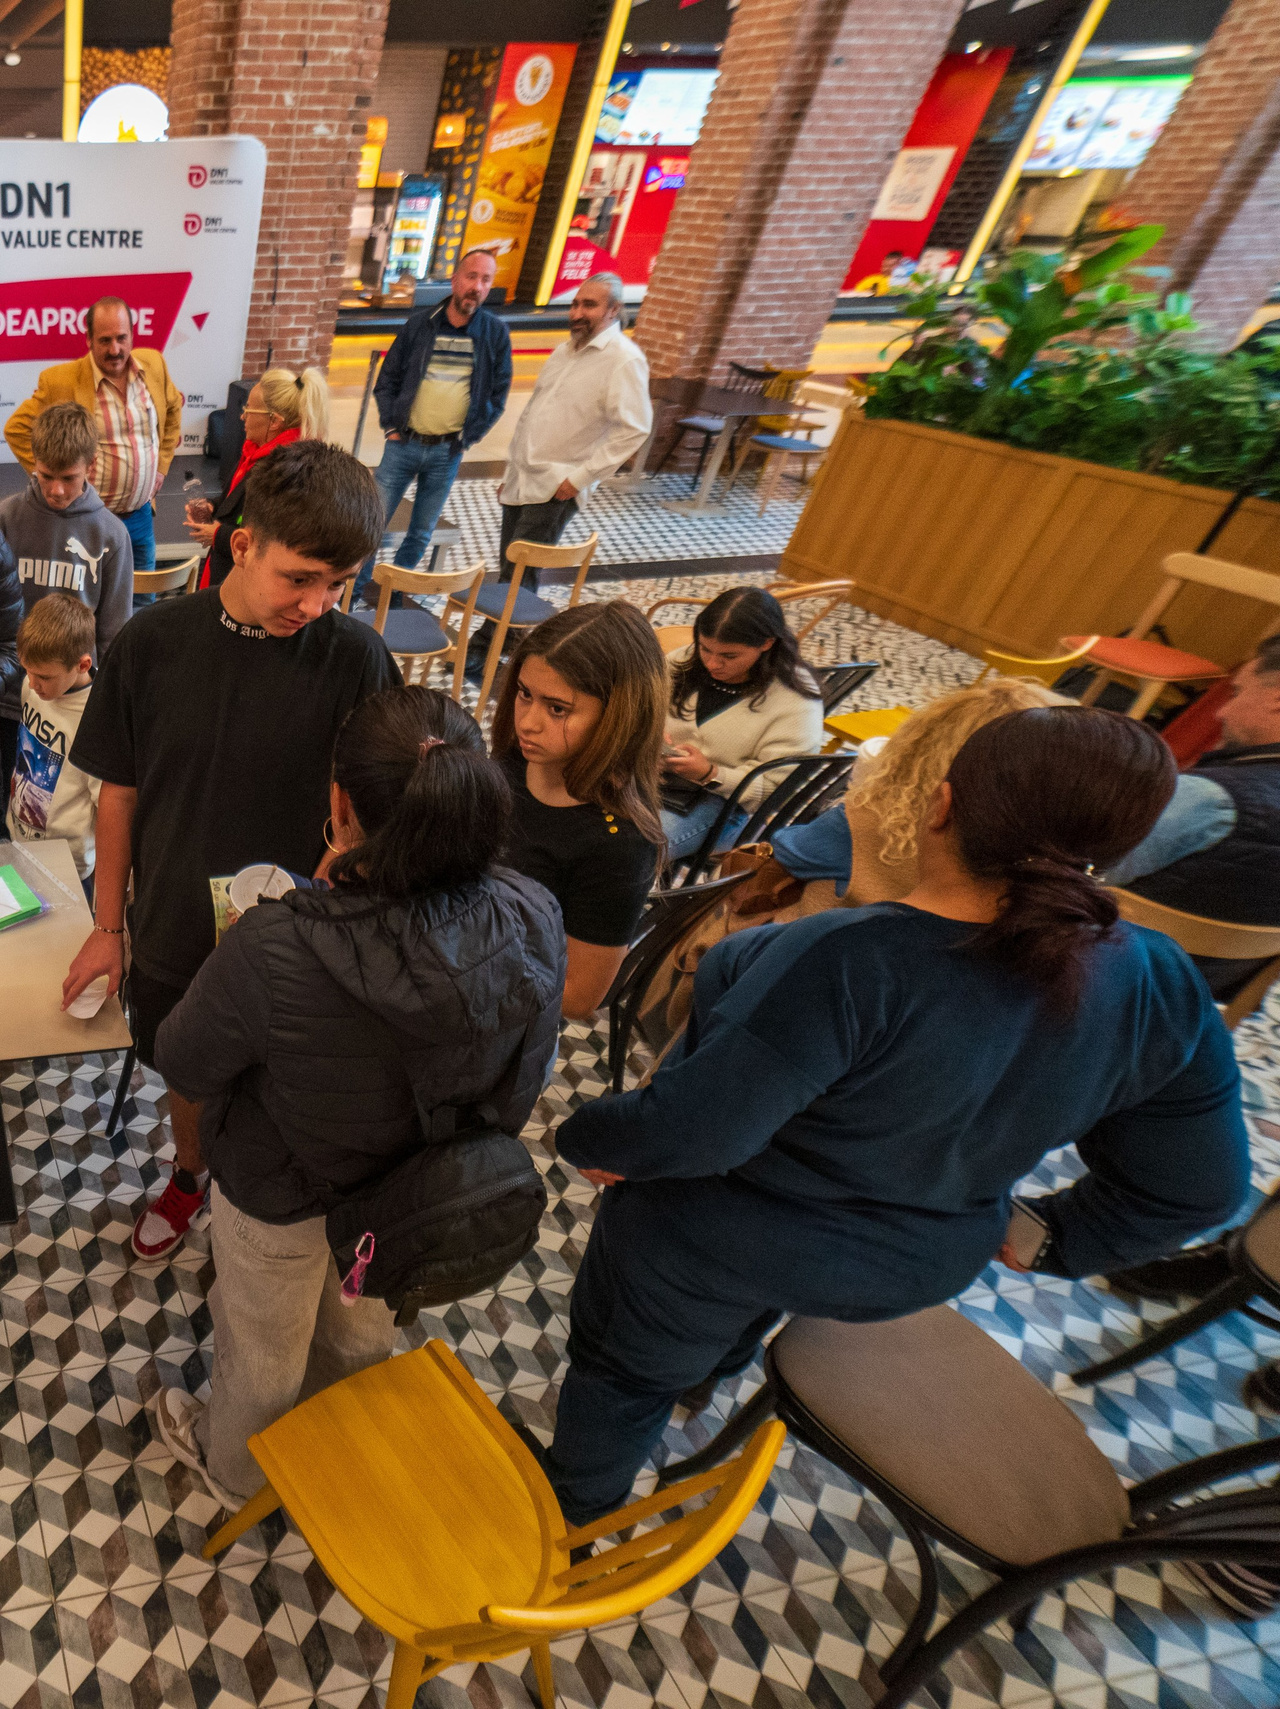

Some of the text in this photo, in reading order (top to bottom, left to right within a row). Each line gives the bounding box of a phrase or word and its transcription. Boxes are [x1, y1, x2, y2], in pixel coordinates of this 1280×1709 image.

[0, 182, 70, 218] DN1
[1, 230, 143, 249] VALUE CENTRE
[18, 558, 87, 592] PUMA
[220, 610, 238, 632] Los
[21, 702, 66, 756] NASA
[212, 881, 221, 892] 50
